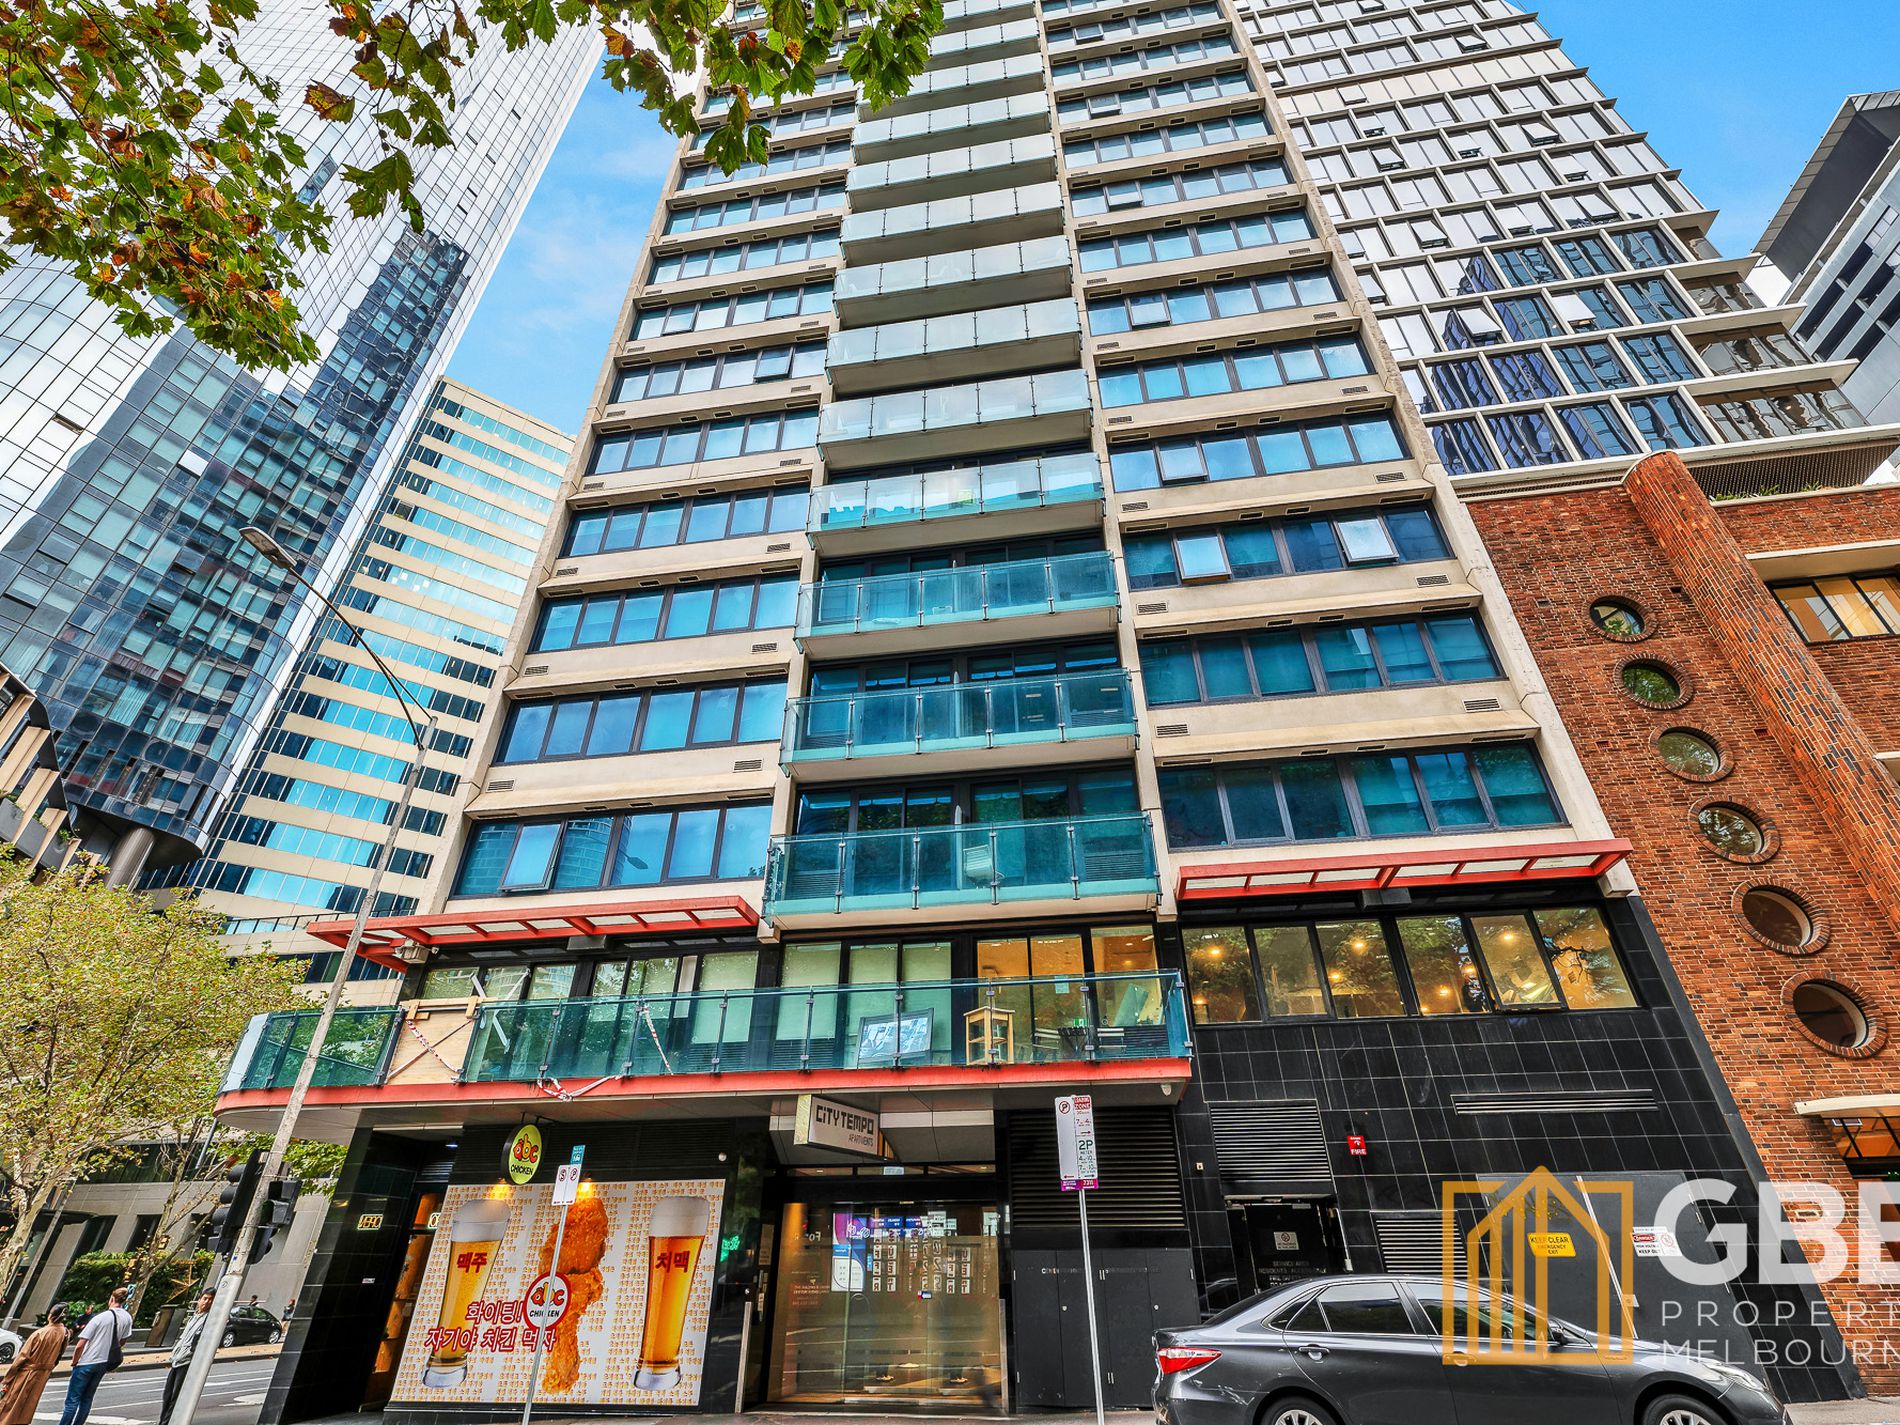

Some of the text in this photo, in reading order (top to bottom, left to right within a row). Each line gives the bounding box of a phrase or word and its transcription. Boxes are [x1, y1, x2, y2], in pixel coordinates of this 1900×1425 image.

[513, 1133, 539, 1163] abc
[1078, 1139, 1094, 1151] 2P
[510, 1164, 534, 1175] CHICKEN
[1547, 1236, 1569, 1244] CLEAR
[456, 1251, 488, 1273] 맥주
[655, 1250, 690, 1273] 치맥
[465, 1299, 524, 1325] 화이팅!
[424, 1326, 479, 1352] 자기야
[480, 1326, 518, 1352] 치킨
